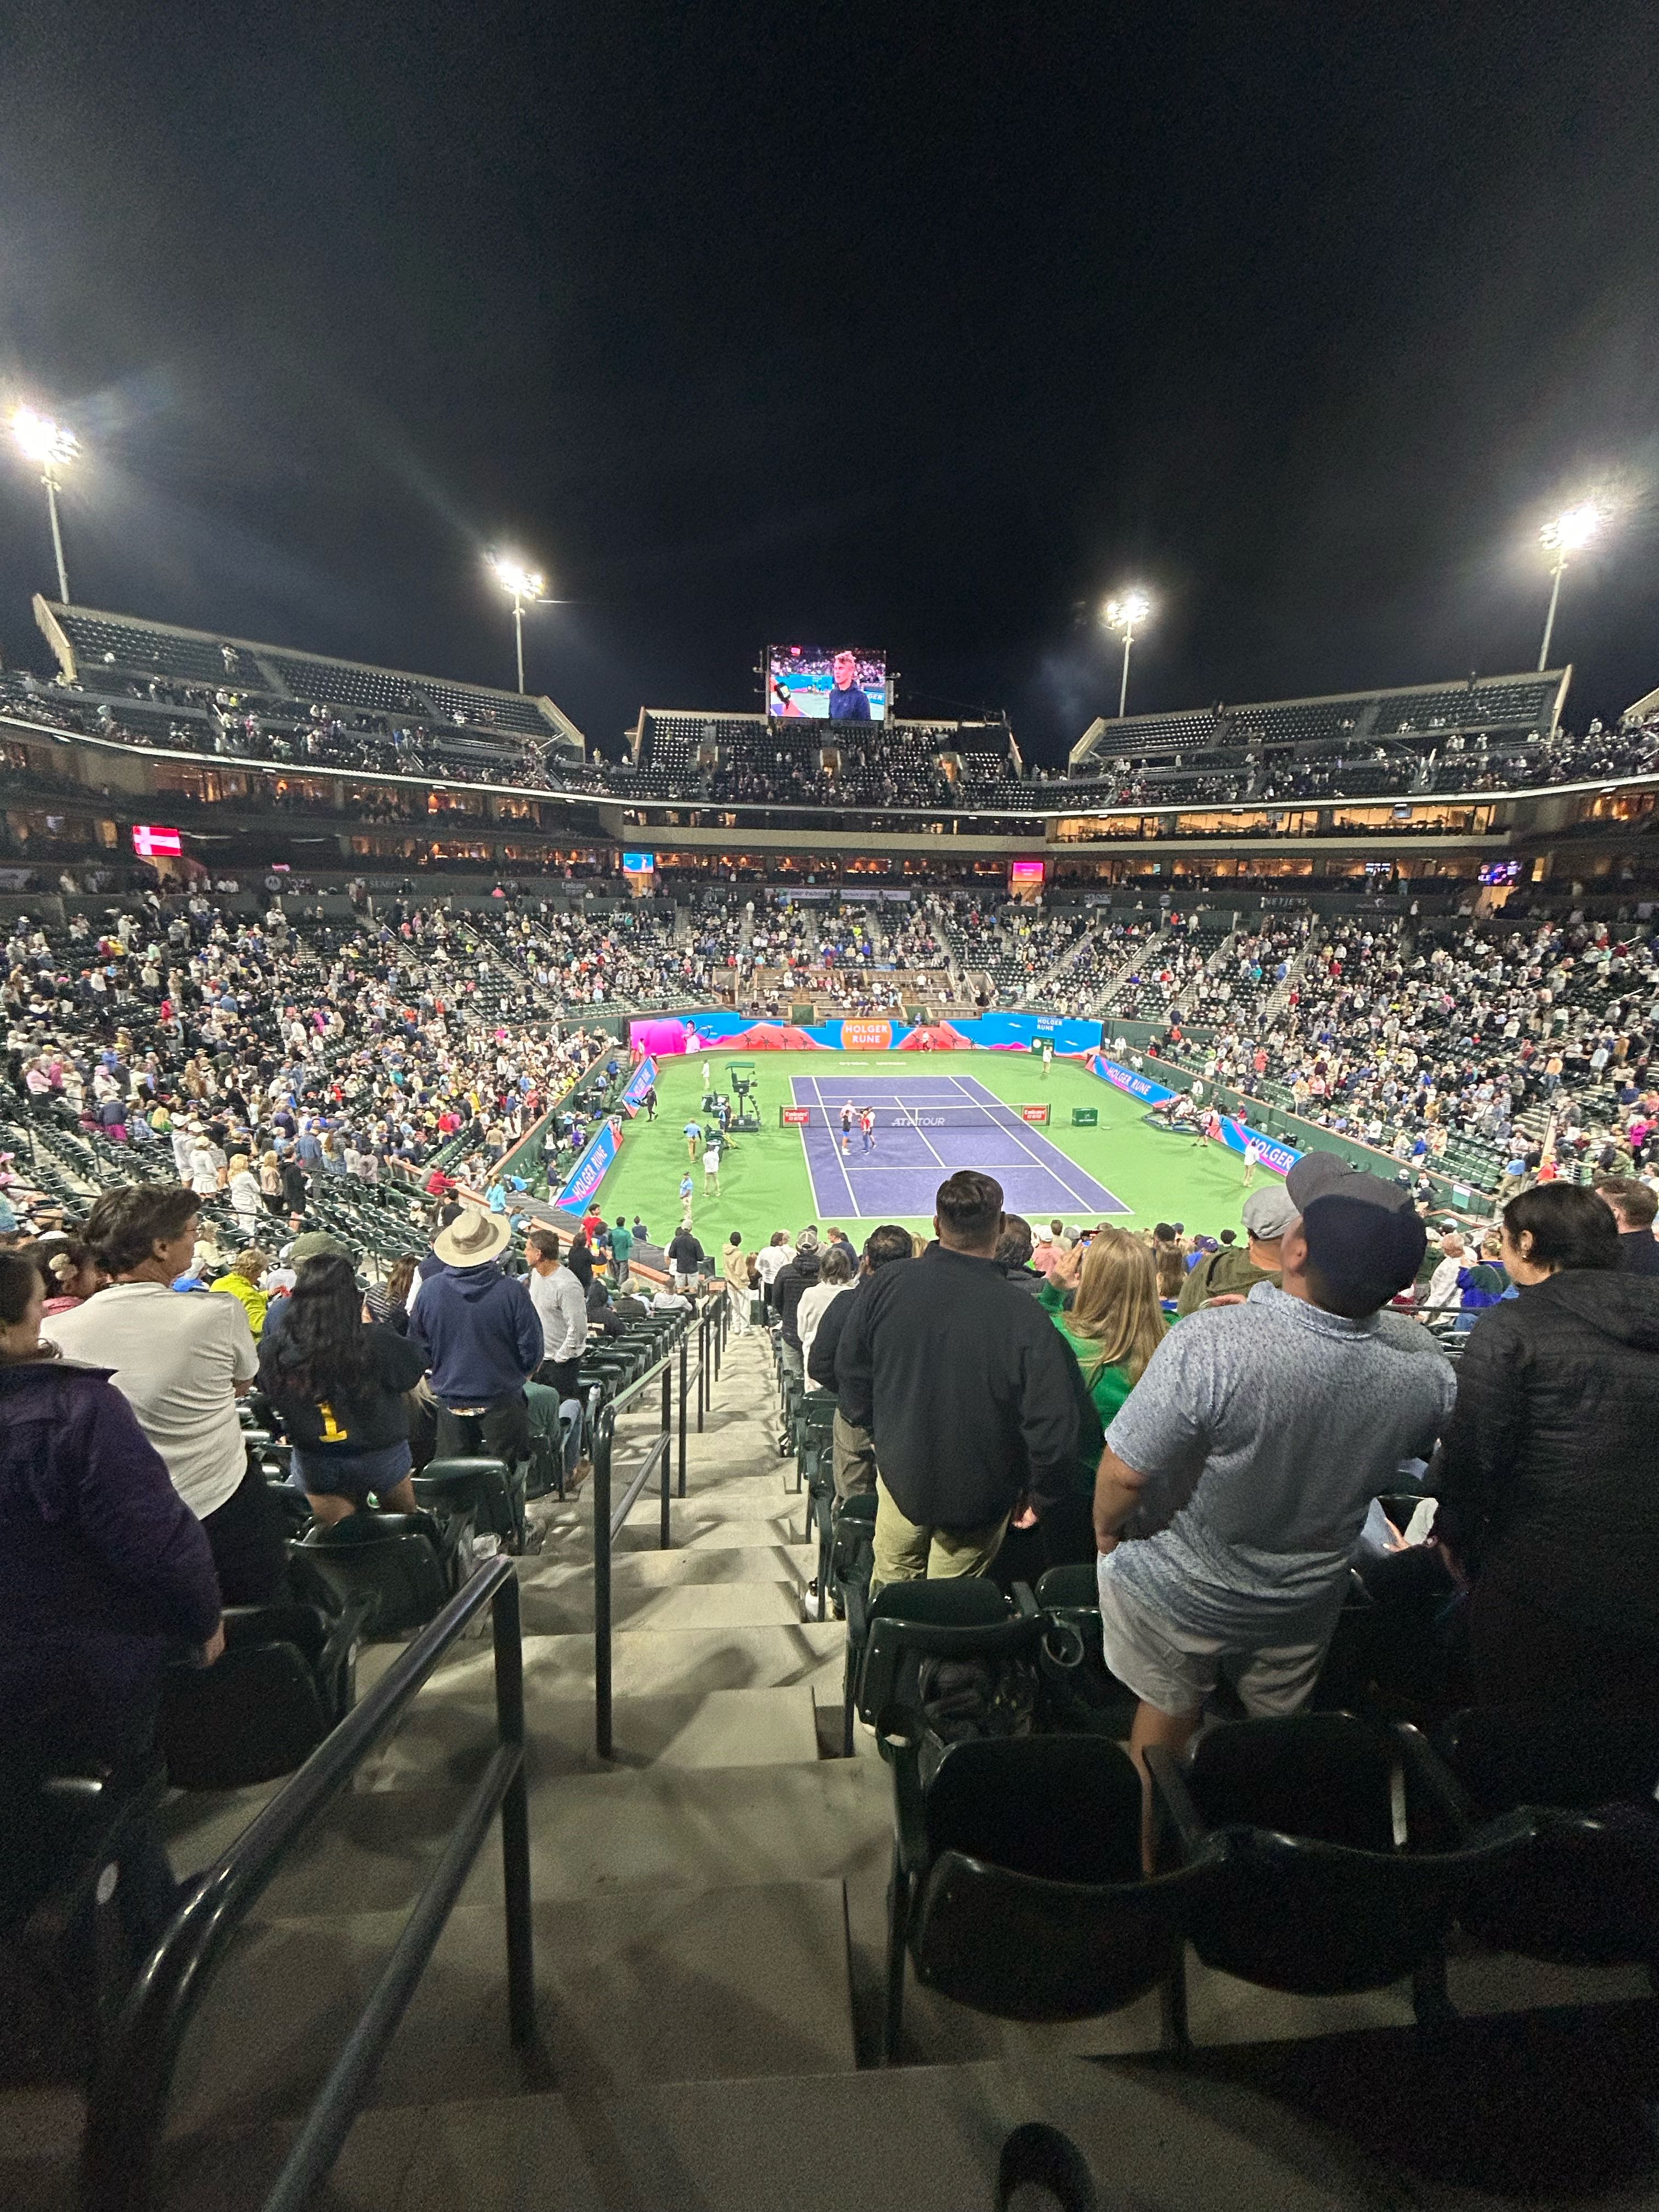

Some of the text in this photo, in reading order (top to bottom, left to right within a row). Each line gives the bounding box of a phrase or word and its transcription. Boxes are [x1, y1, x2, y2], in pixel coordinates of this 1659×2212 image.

[845, 1025, 888, 1033] HOLGER
[1107, 1066, 1152, 1095] HOLGER RUNE
[917, 1118, 945, 1126] TOUR
[572, 1144, 608, 1201] HOLGER RUNE
